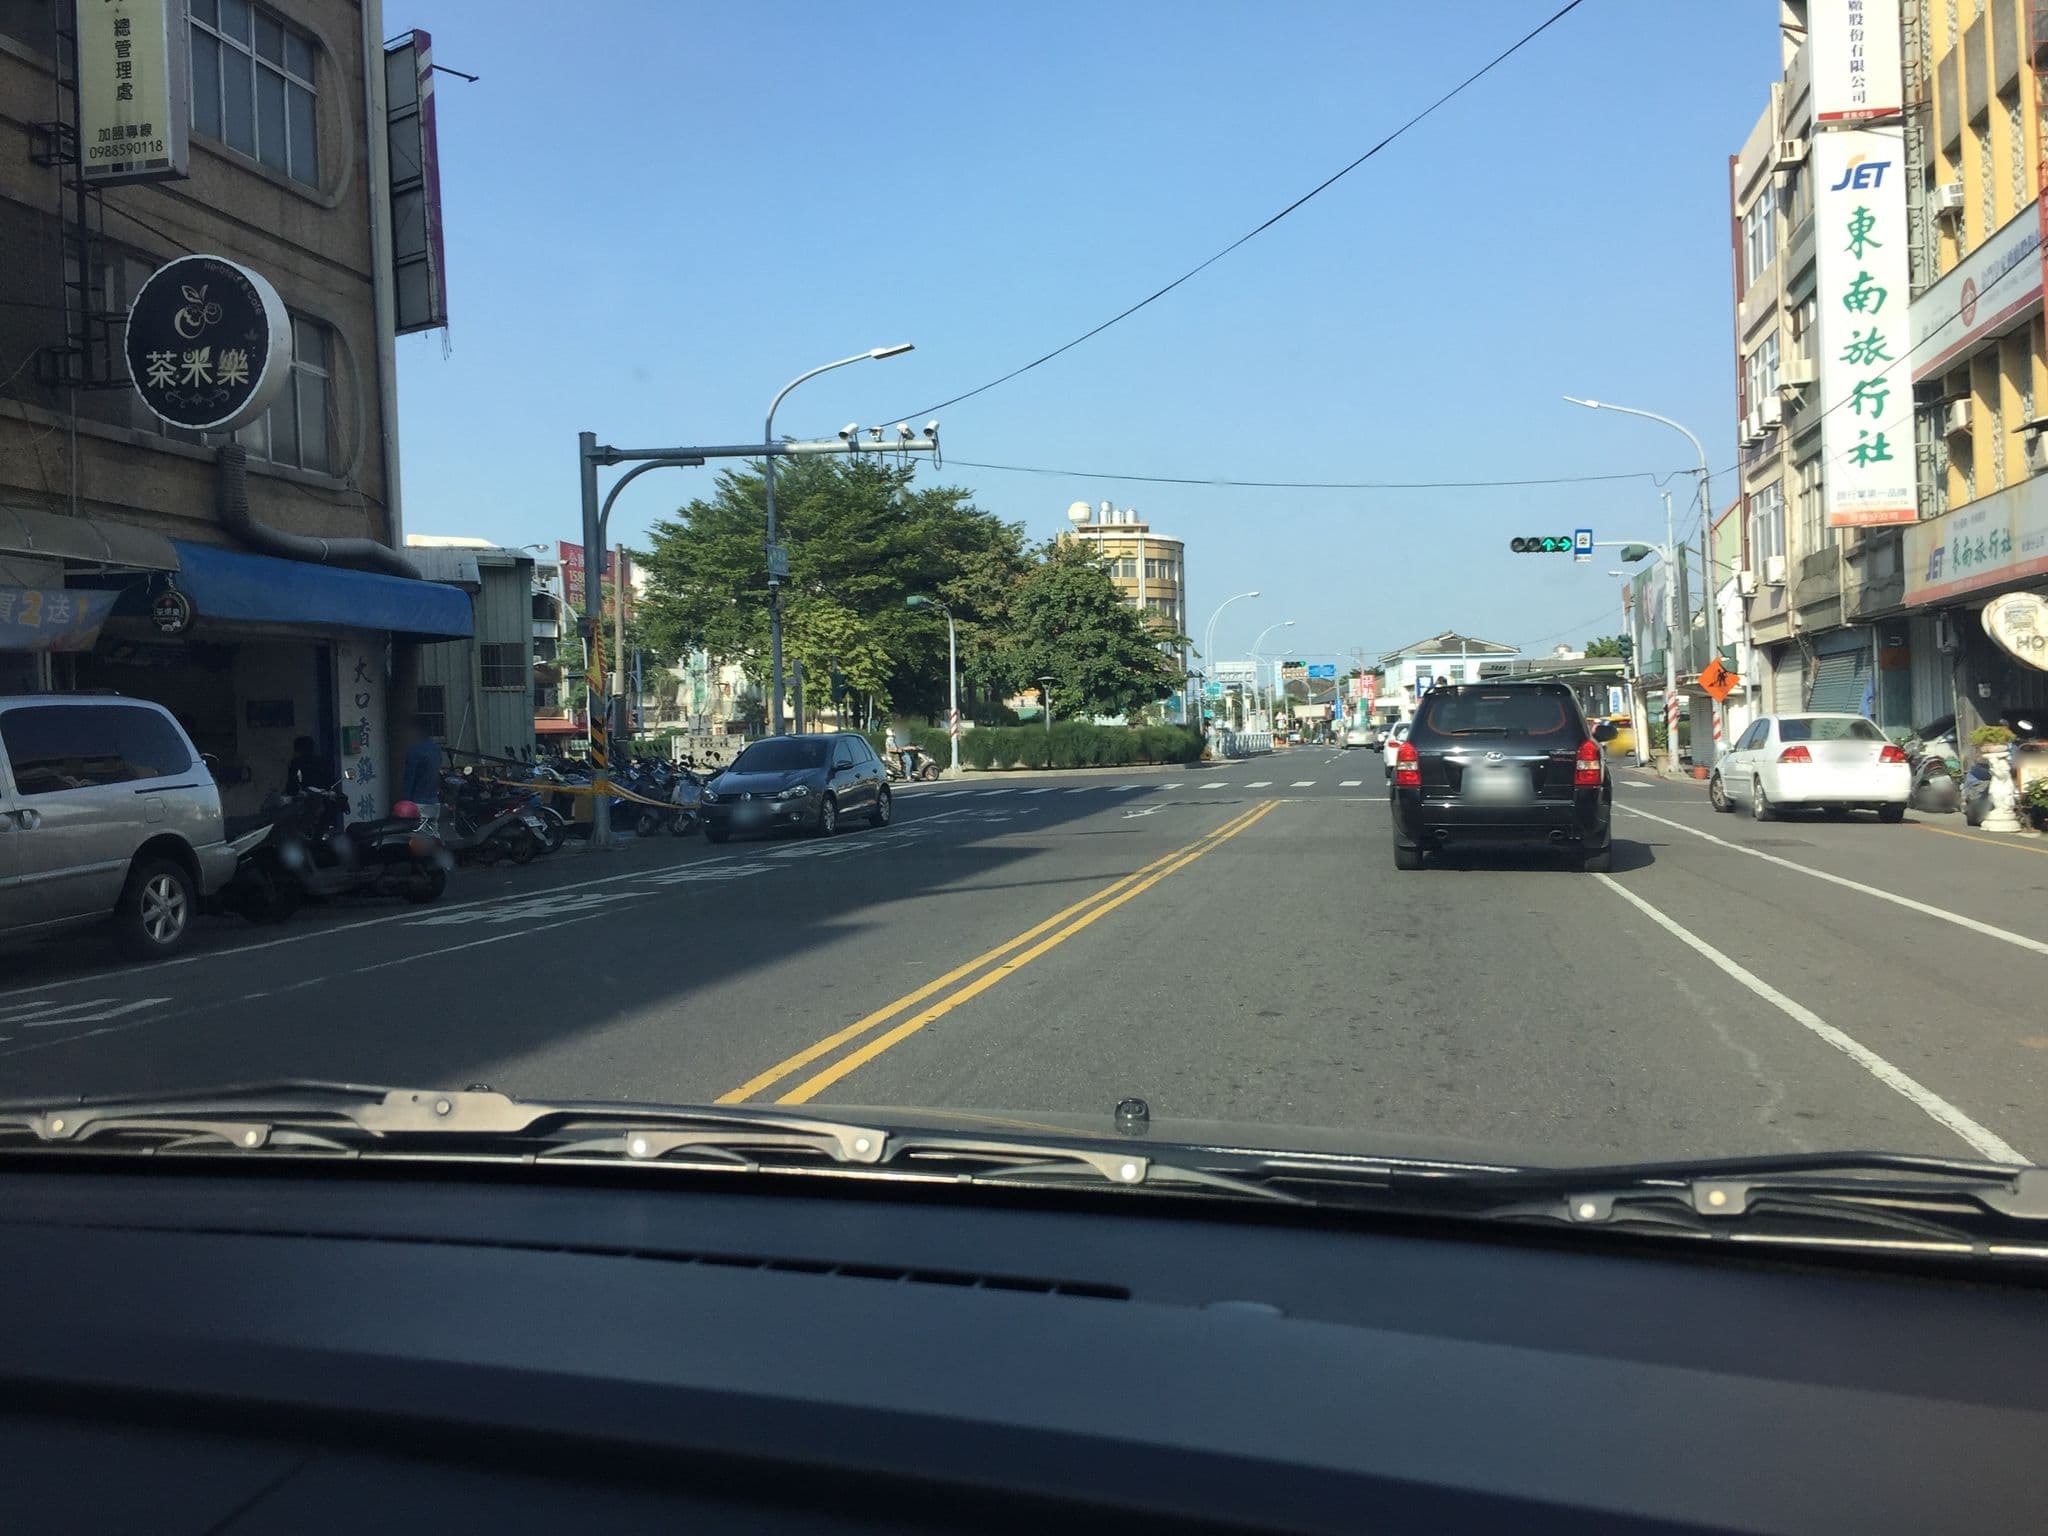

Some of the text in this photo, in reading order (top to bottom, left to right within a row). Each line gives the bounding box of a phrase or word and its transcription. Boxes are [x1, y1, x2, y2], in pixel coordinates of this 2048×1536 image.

[89, 139, 164, 159] 0988590118
[98, 122, 152, 142] 加盟專線
[1830, 159, 1892, 193] JET
[1839, 205, 1895, 469] 東南旅行社
[146, 346, 249, 389] 茶米樂
[1925, 546, 1945, 582] JET
[1951, 527, 2013, 573] 東南旅行社
[2016, 634, 2048, 652] HO
